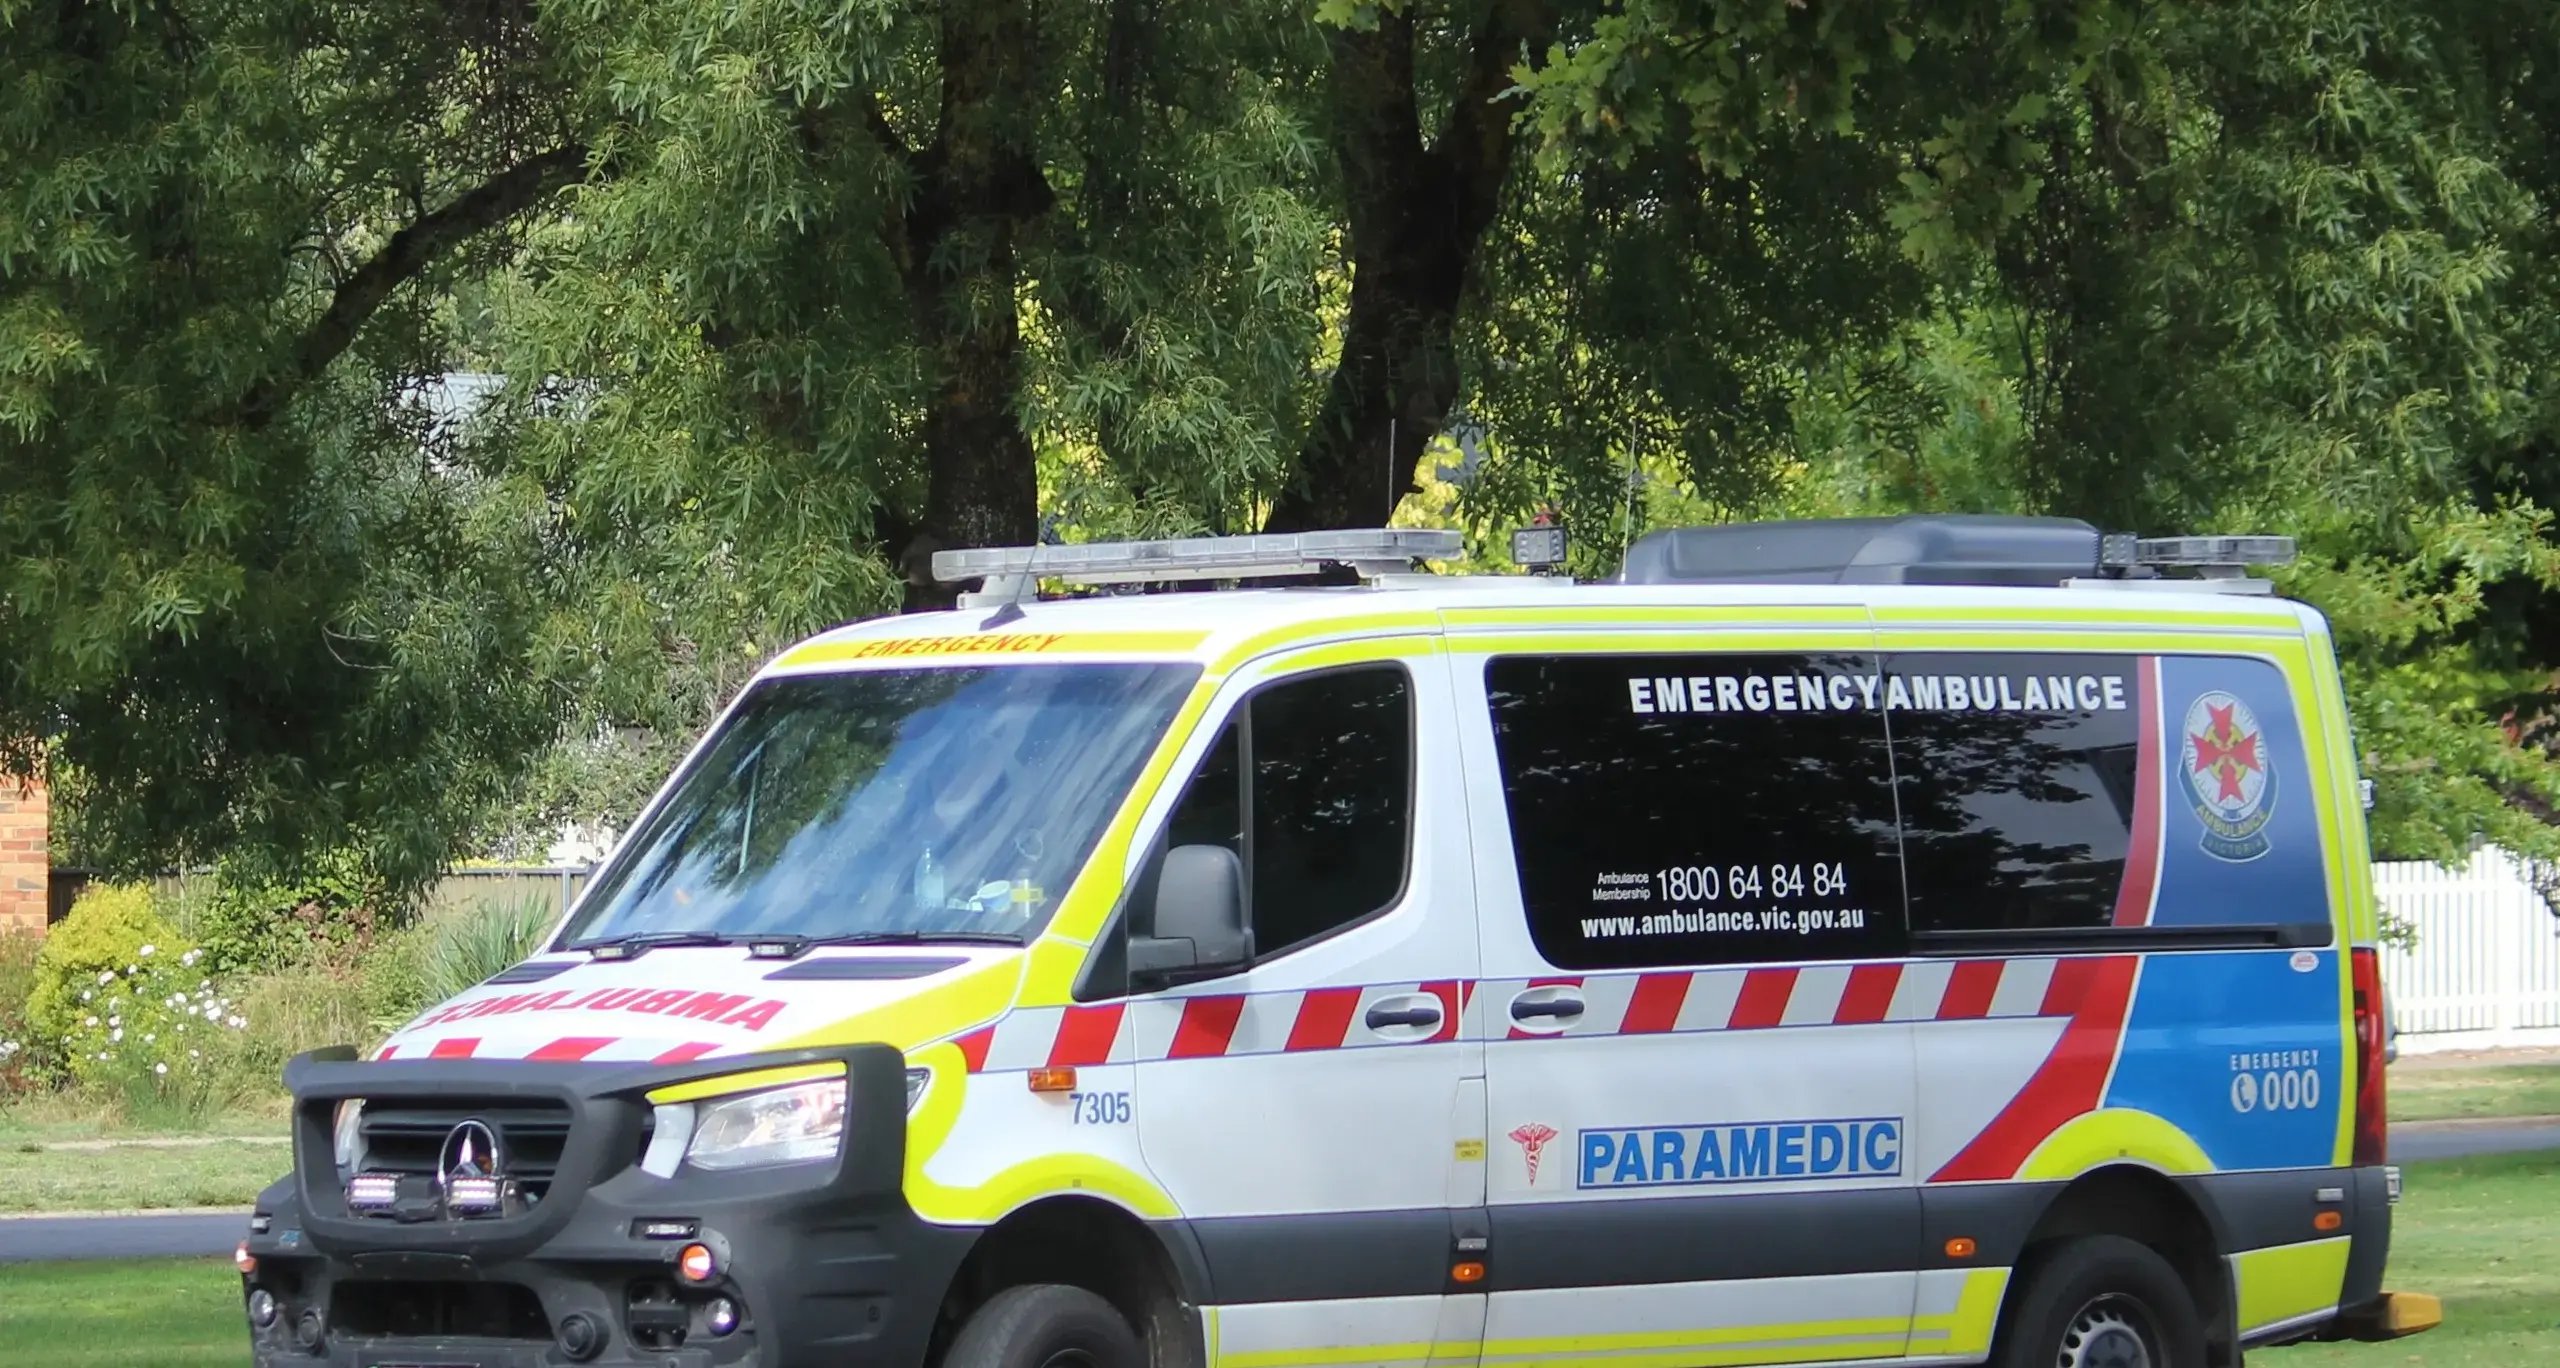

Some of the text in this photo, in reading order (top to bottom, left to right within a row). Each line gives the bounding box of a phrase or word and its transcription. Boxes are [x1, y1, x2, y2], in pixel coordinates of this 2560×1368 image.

[853, 634, 1066, 658] EMERGENCY
[1628, 675, 2127, 713] EMERGENCY AMBULANCE
[2195, 805, 2268, 837] AMBULANCE
[1592, 888, 1651, 901] Membership
[1597, 872, 1650, 885] Ambulance
[1656, 862, 1847, 901] 1800 64 84 84
[1581, 906, 1865, 938] www.ambulance.vic.gov.au
[2231, 1049, 2320, 1071] EMERGENCY
[2263, 1069, 2320, 1111] 000
[1069, 1092, 1131, 1125] 7305
[1582, 1122, 1898, 1184] PARAMEDIC
